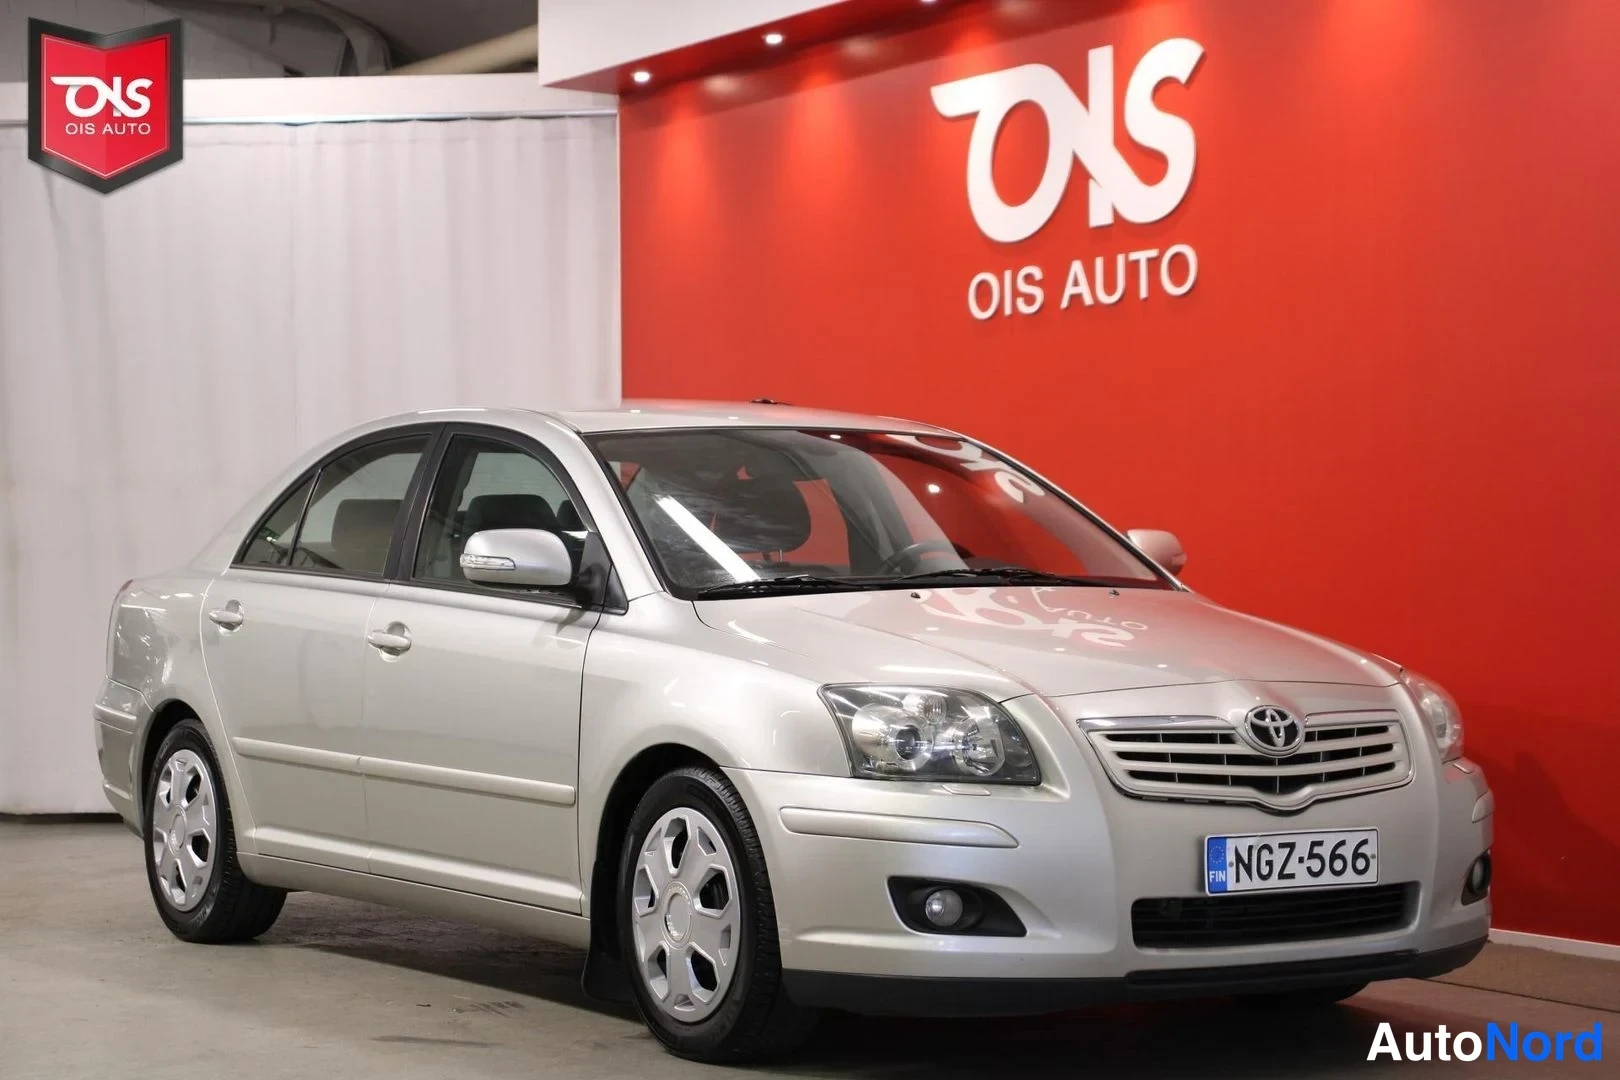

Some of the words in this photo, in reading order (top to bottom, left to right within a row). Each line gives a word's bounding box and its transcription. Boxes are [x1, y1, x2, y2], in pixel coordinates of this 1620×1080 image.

[967, 265, 1045, 320] OIS
[1060, 243, 1198, 309] AUTO
[1209, 870, 1226, 883] FIN
[1234, 838, 1371, 884] NGZ-566
